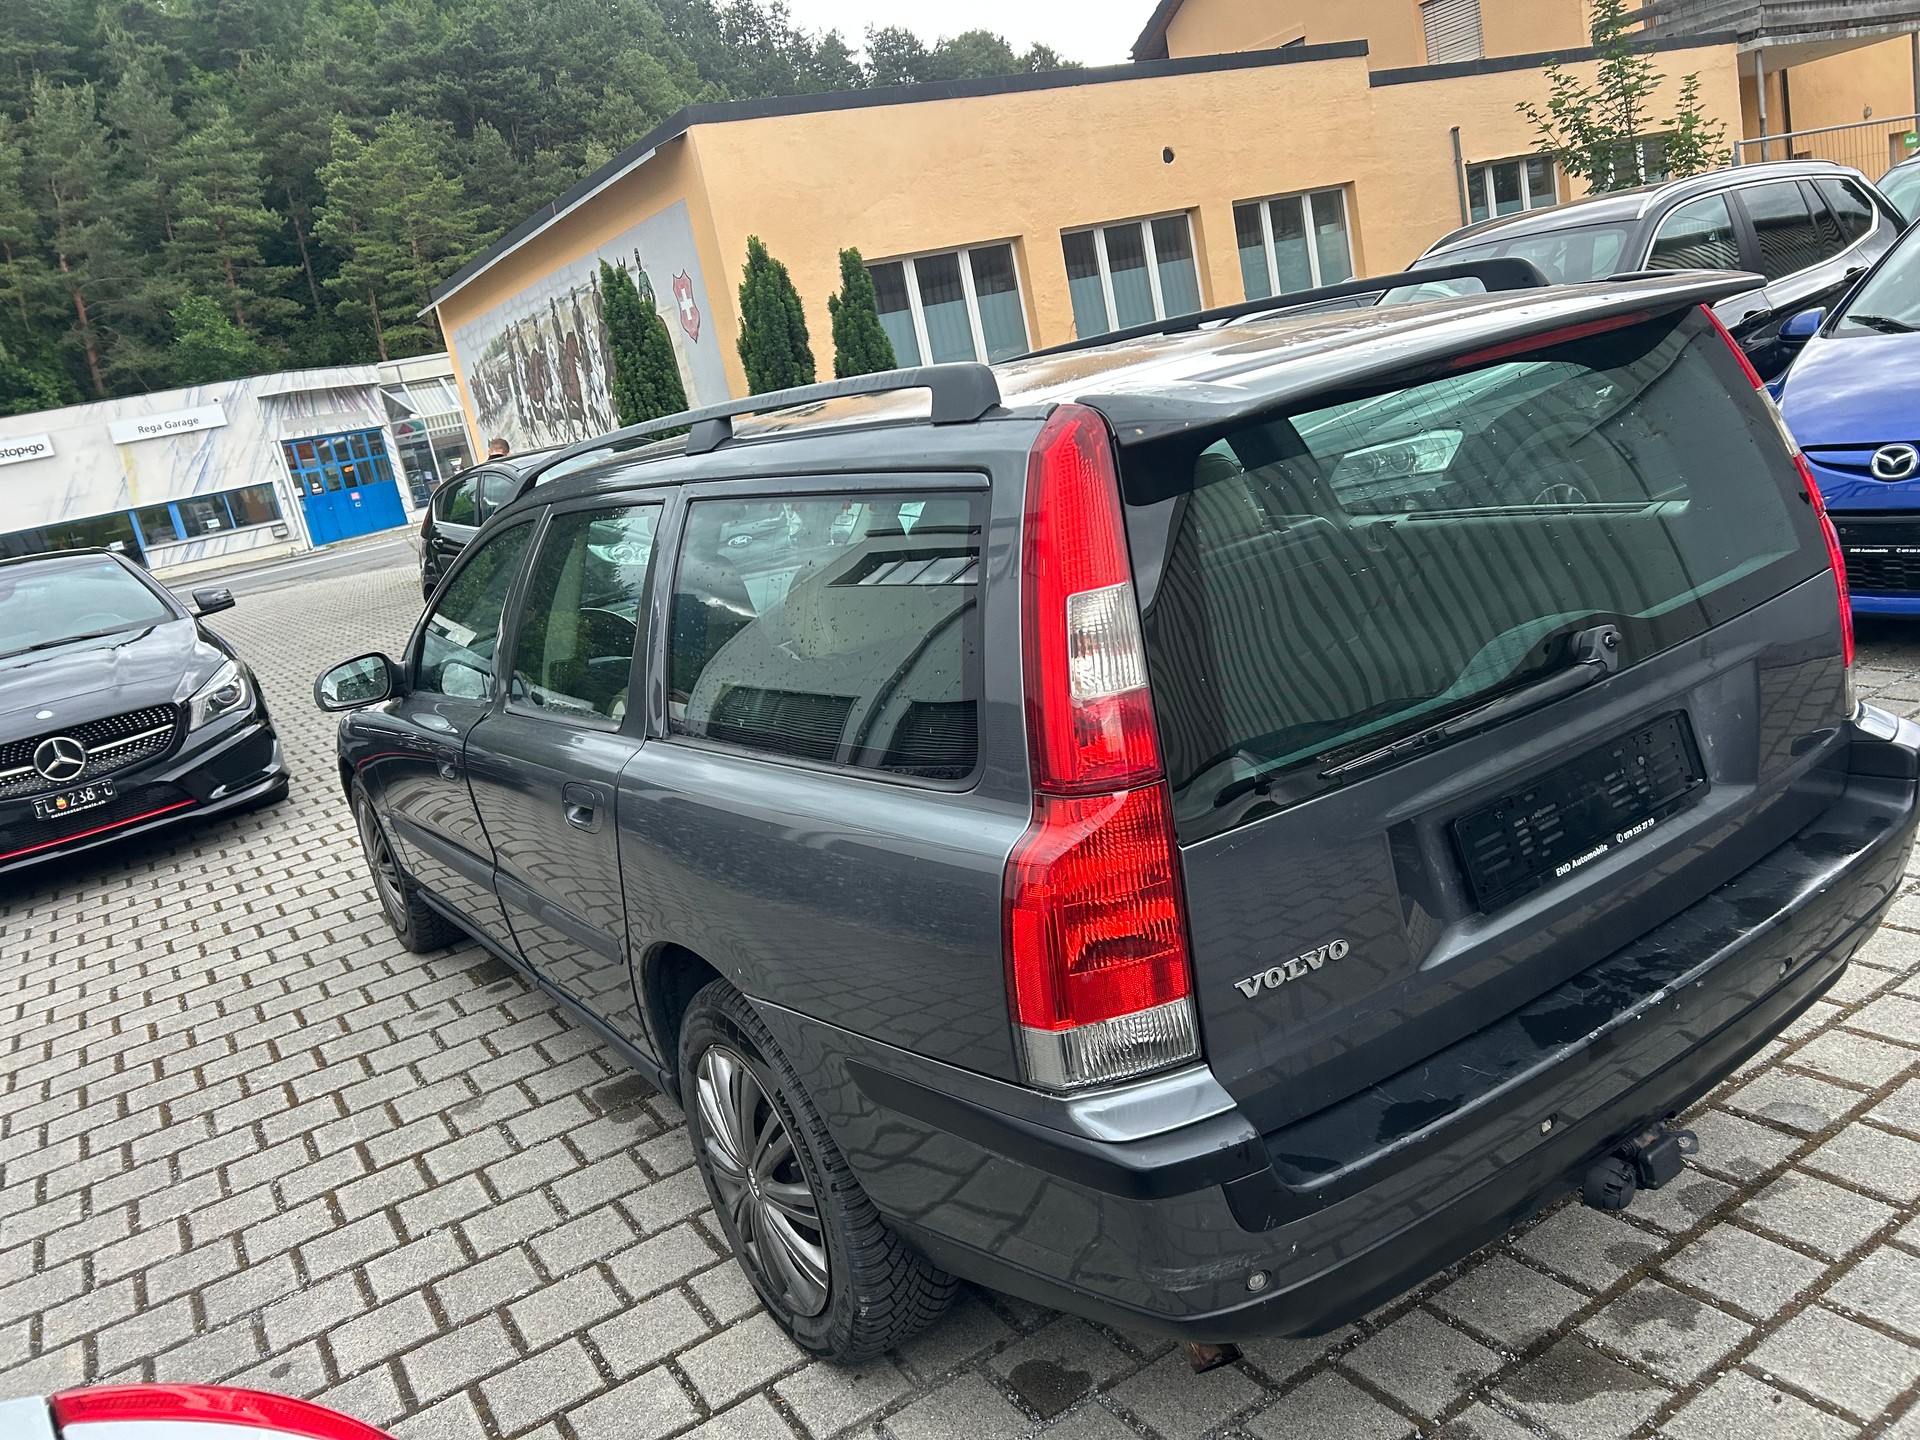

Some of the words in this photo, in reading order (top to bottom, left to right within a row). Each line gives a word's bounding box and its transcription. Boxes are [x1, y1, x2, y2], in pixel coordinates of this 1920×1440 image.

[137, 423, 162, 434] Rega
[164, 417, 199, 430] Garage
[0, 442, 45, 458] stop+go
[34, 799, 55, 819] FL
[67, 787, 95, 808] 238
[1555, 862, 1572, 877] END
[1572, 844, 1608, 868] Automobile
[1233, 938, 1350, 999] VOLVO
